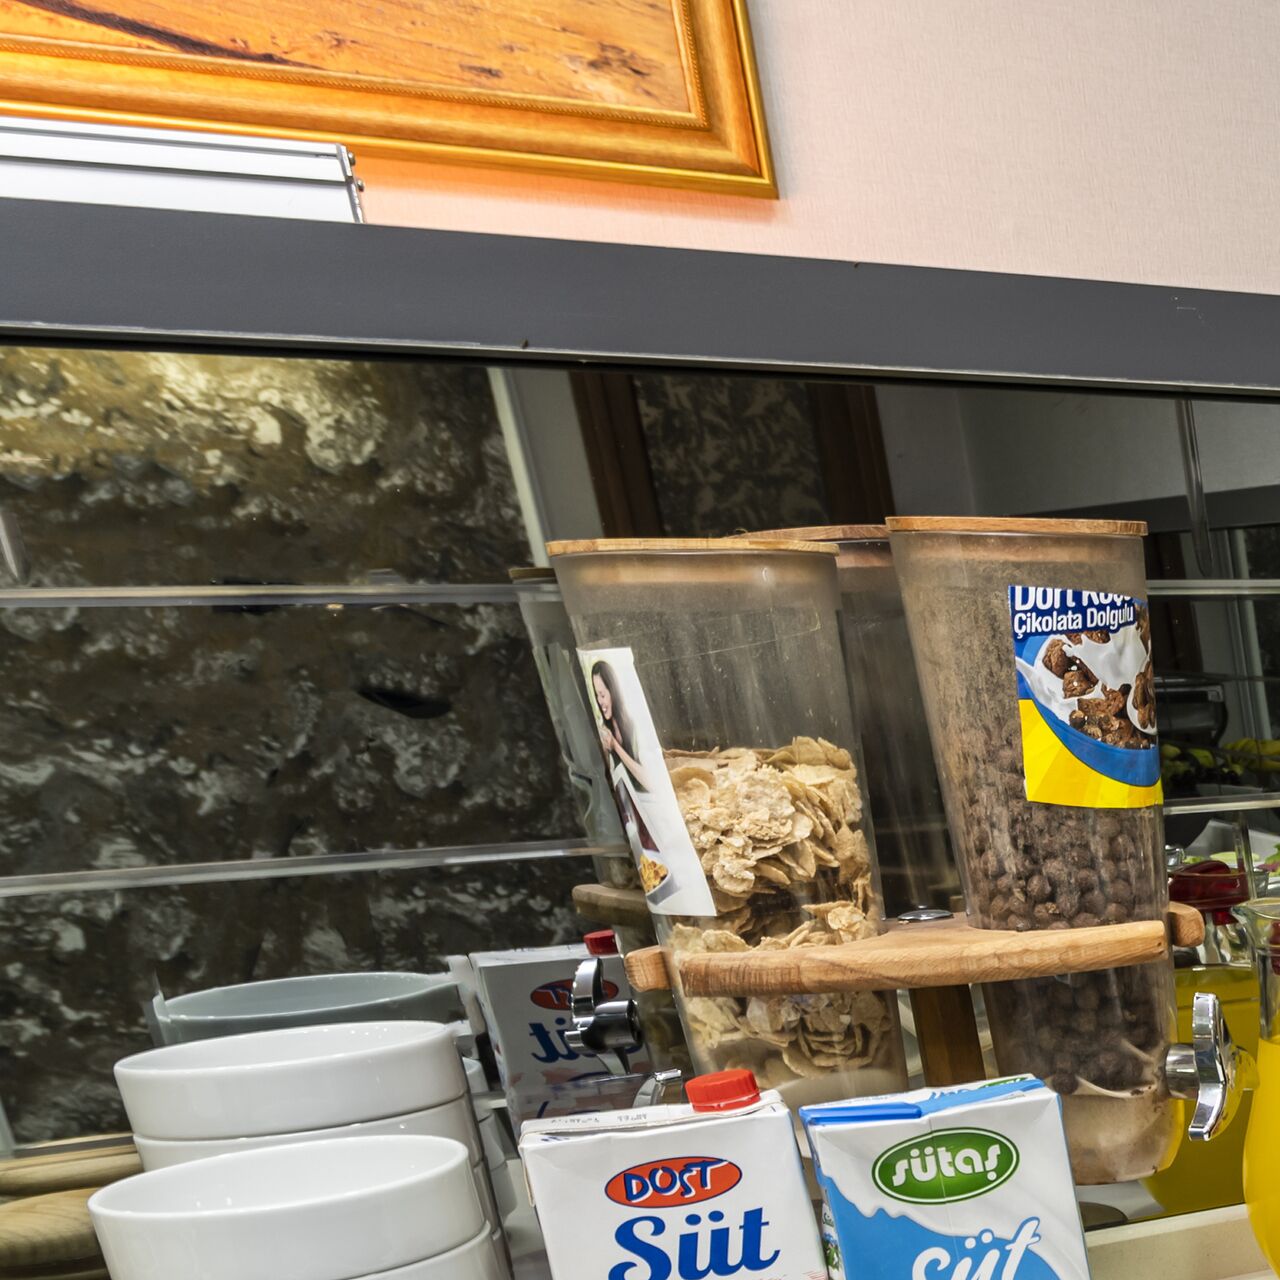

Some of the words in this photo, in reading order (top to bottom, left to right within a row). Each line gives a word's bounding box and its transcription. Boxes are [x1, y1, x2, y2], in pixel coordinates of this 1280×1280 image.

[1014, 610, 1082, 639] Çikolata
[1087, 603, 1134, 630] Dolgulu
[624, 1160, 728, 1202] DOST
[892, 1144, 1001, 1187] sütaş
